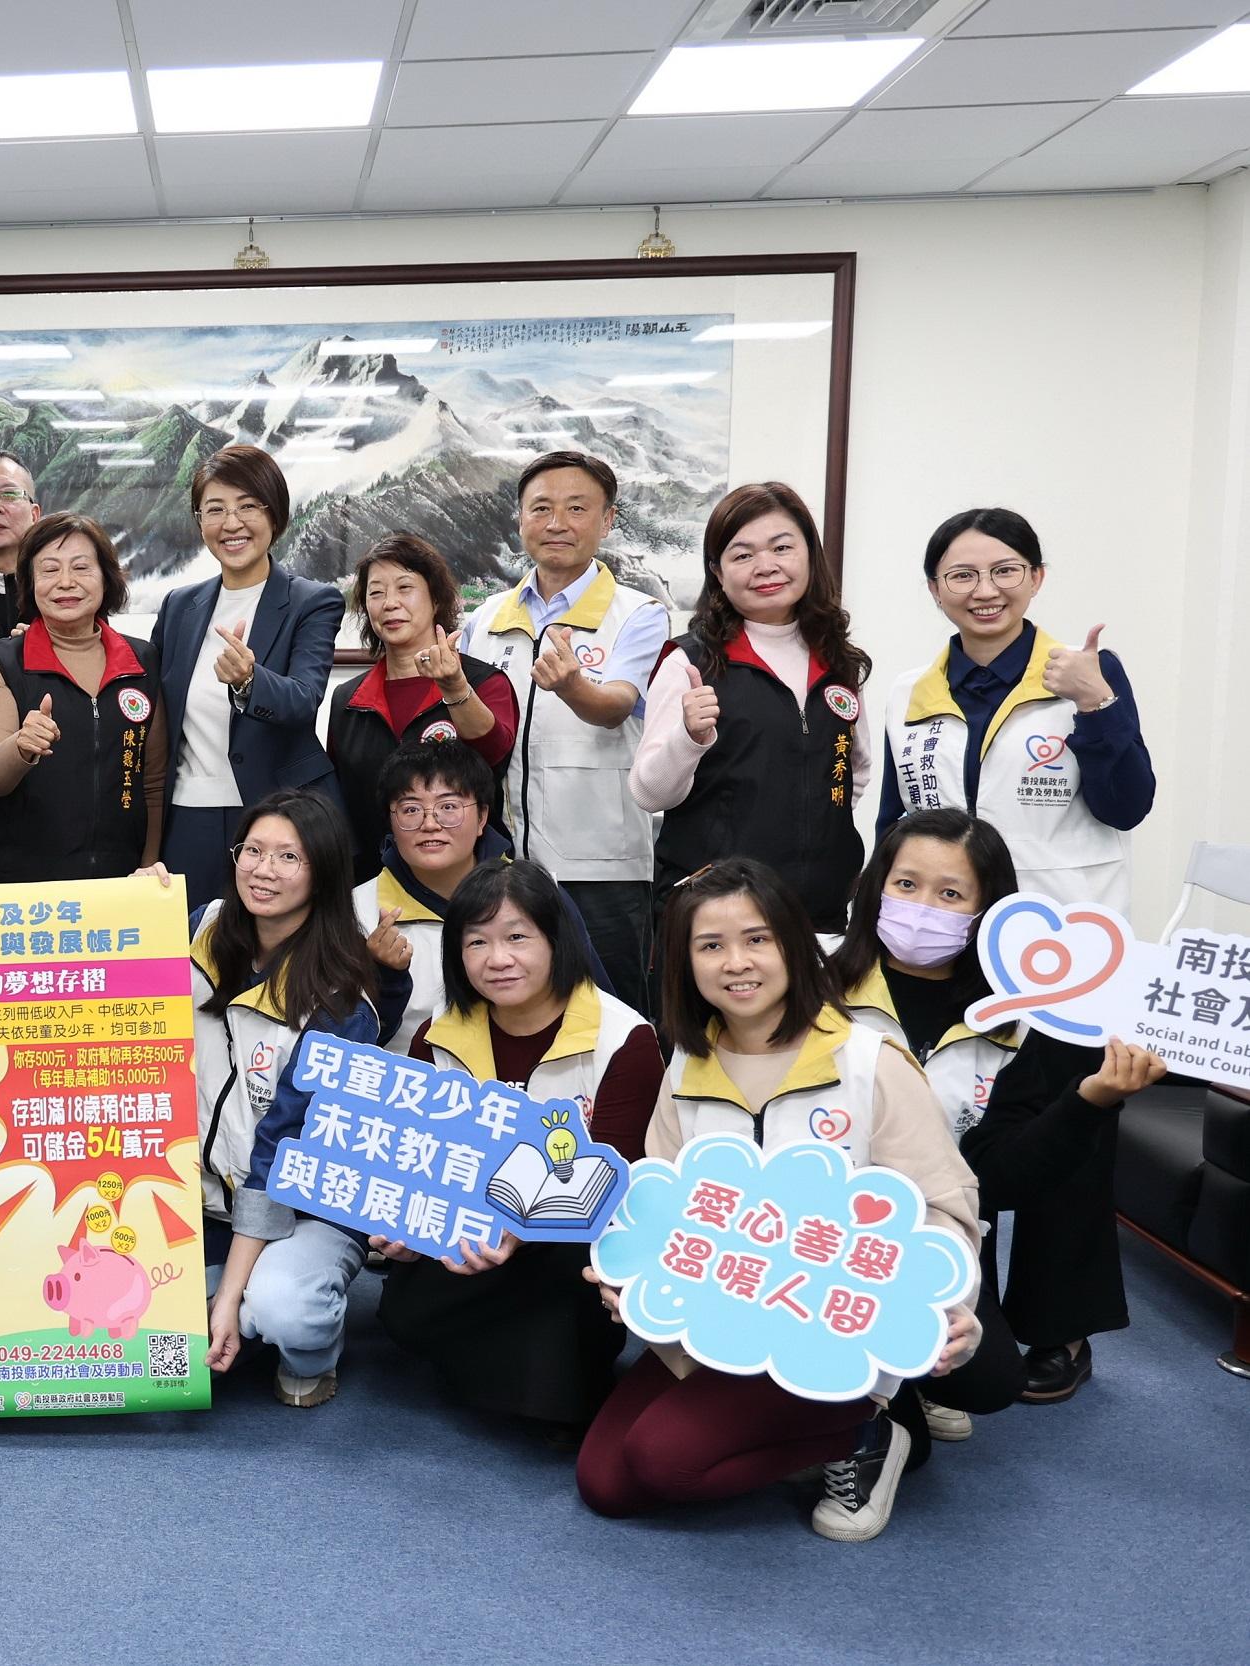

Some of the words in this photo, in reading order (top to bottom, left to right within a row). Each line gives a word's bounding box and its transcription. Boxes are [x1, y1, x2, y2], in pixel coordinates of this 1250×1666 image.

[831, 734, 849, 807] 黃秀明
[902, 732, 918, 757] 科長
[920, 720, 944, 809] 社會救助科
[1016, 787, 1072, 797] 社會及勞動局
[1021, 777, 1068, 786] 南投縣政府
[1135, 1022, 1184, 1043] Social
[1188, 1038, 1220, 1050] and
[1146, 1043, 1205, 1066] Nantou
[11, 1092, 173, 1127] 存到滿18歲預估最高
[301, 1041, 520, 1141] 兒童及少年
[21, 1125, 166, 1162] 可儲金54萬元
[313, 1102, 486, 1193] 未來教育
[276, 1148, 495, 1250] 與發展帳戶
[686, 1181, 902, 1281] 愛心善舉
[663, 1231, 877, 1333] 溫暖人間
